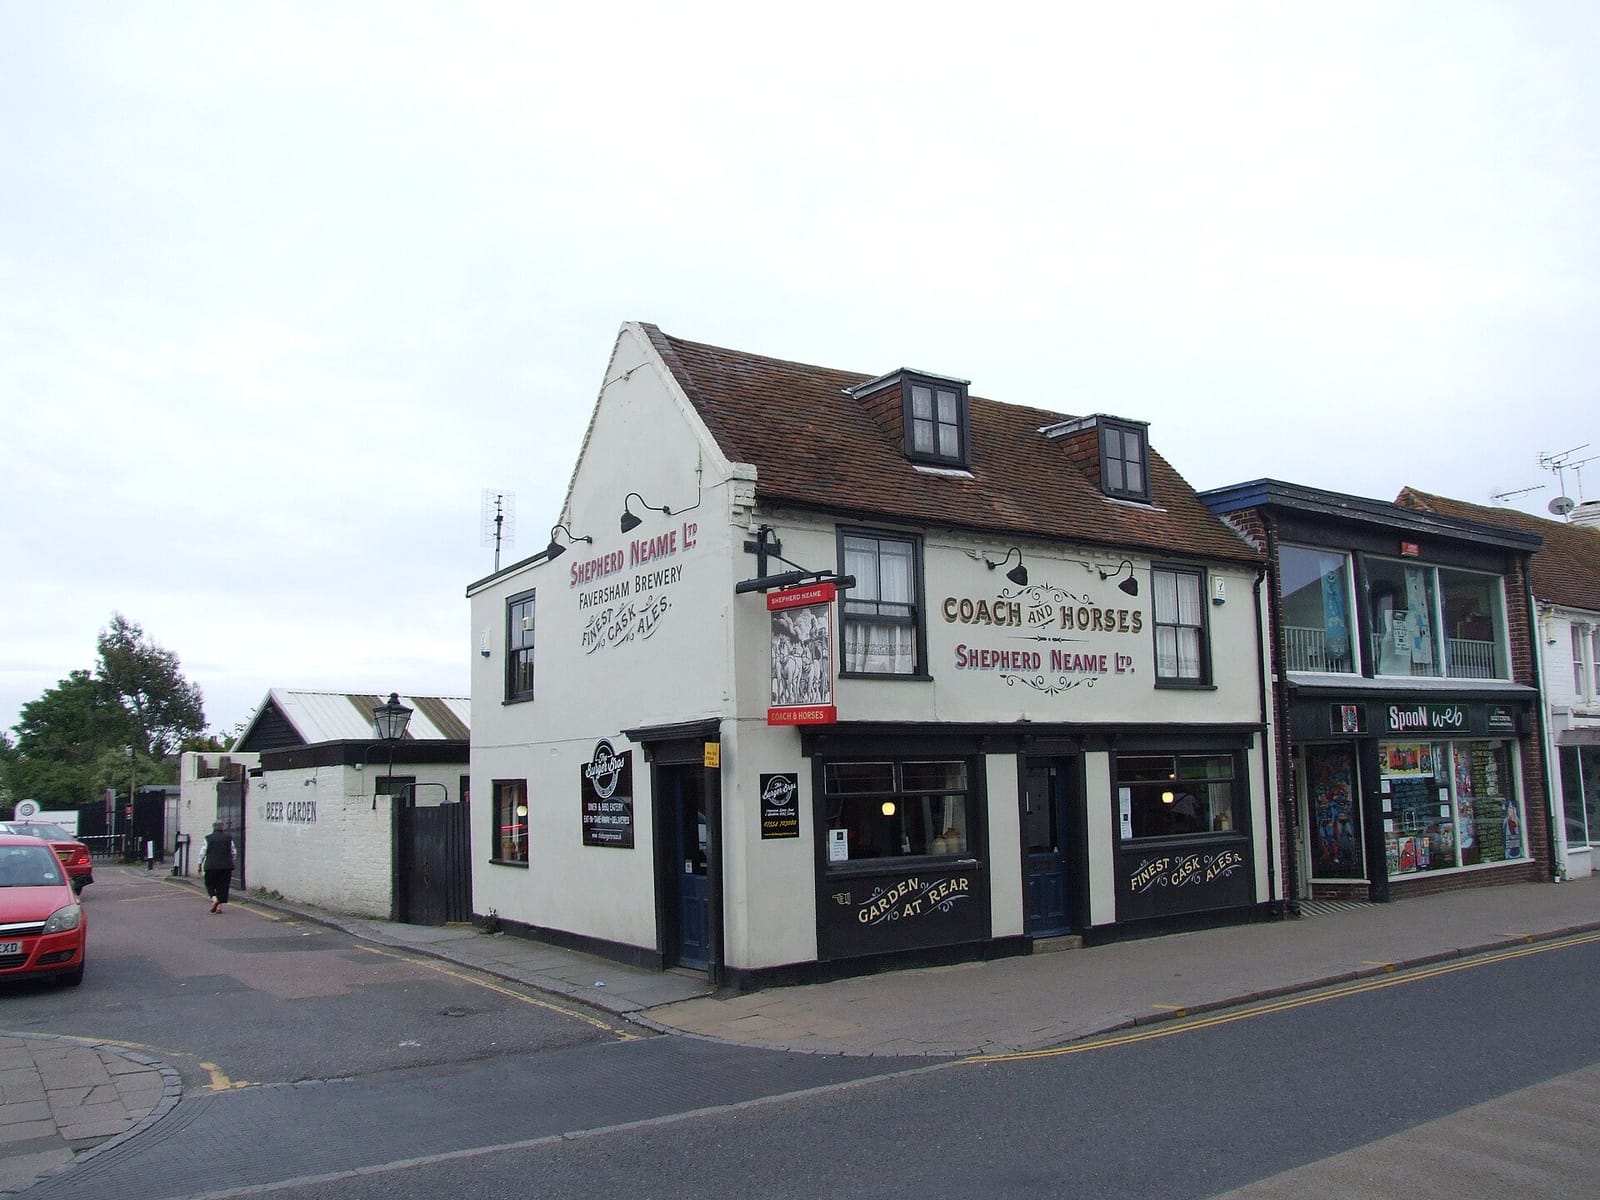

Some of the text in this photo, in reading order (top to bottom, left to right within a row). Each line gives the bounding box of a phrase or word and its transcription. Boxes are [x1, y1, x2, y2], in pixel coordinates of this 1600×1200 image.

[570, 550, 625, 587] SHEPHERD
[631, 529, 677, 567] NEAME
[579, 564, 683, 610] FAVERSHAM BREWERY
[771, 590, 822, 605] SHEPHERD NEAME
[582, 608, 614, 646] FINEST
[608, 604, 637, 641] CASK
[942, 597, 1143, 633] COACH AND HORSES
[955, 644, 1041, 671] SHEPHERD
[1051, 649, 1108, 674] NEAME
[771, 712, 791, 721] COACH
[798, 710, 824, 720] HORSES
[266, 800, 317, 824] BEER GARDEN
[1130, 858, 1170, 891] FINEST
[1171, 857, 1201, 886] CASK
[858, 877, 919, 923] GARDEN
[902, 878, 969, 917] AT REAR
[0, 943, 18, 953] XD
